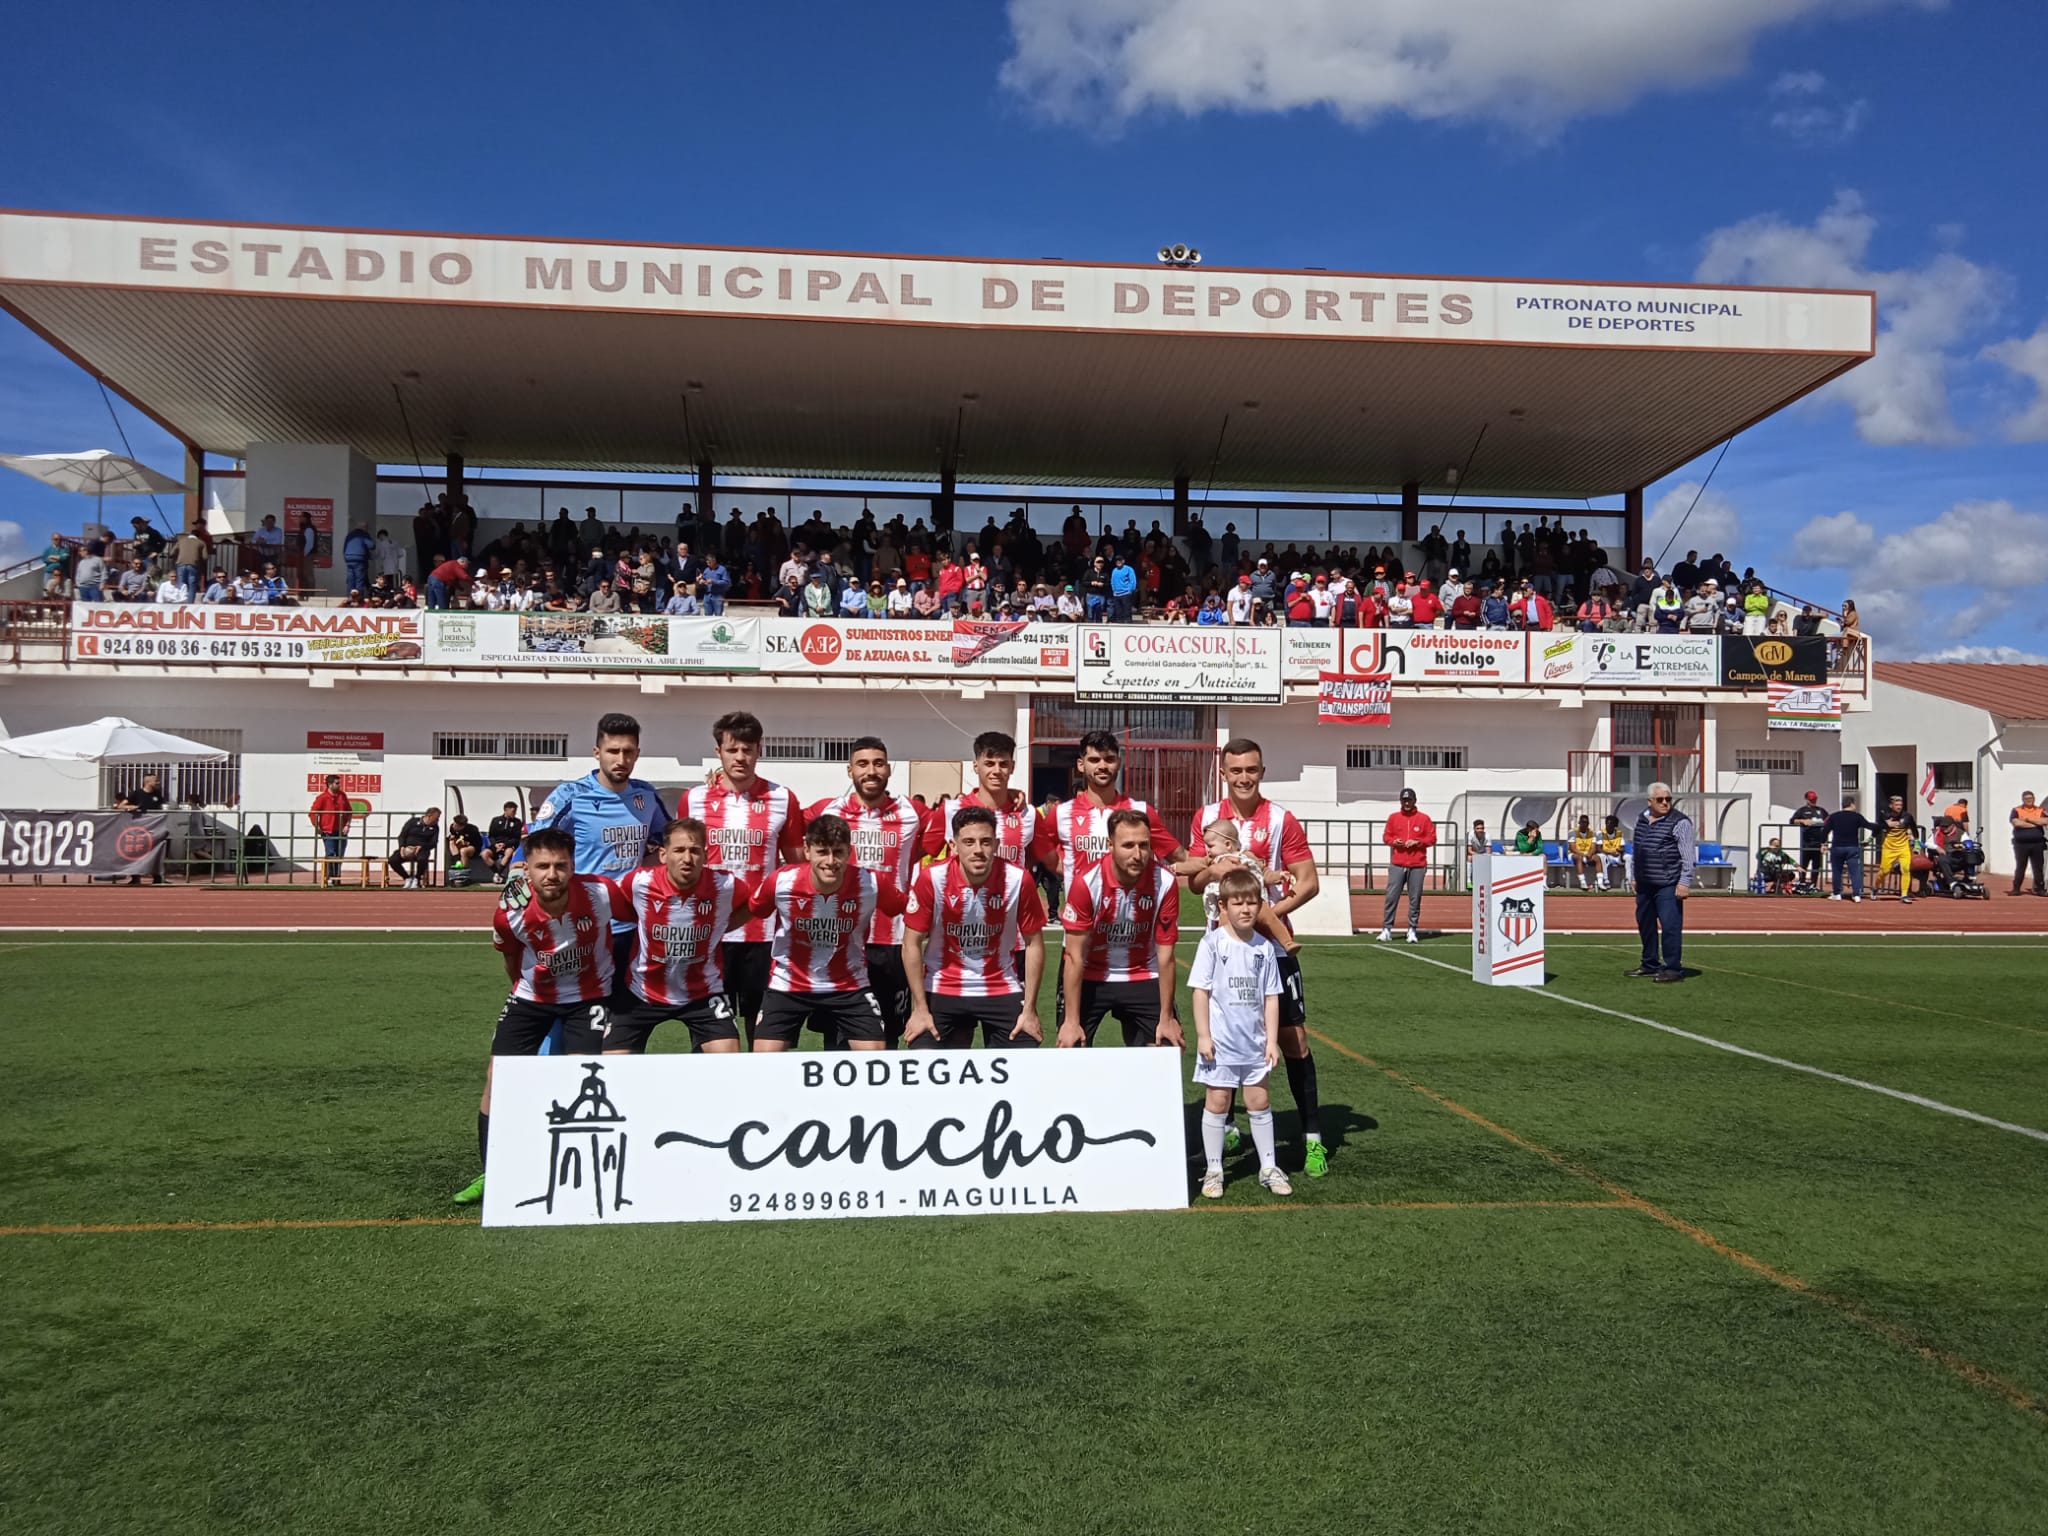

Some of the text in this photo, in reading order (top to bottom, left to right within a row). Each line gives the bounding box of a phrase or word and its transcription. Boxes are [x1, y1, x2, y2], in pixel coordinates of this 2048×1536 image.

[140, 237, 1473, 325] ESTADIO MUNICIPAL DE DEPORTES
[1516, 297, 1743, 317] PATRONATO MUNICIPAL
[1568, 316, 1696, 333] DE DEPORTES
[81, 606, 418, 634] JOAQUÍN BUSTAMANTE
[846, 628, 923, 641] SUMINISTROS
[1024, 634, 1038, 643] 924
[1040, 634, 1055, 644] 137
[1056, 635, 1069, 644] 781
[1410, 634, 1520, 650] distribuciones
[103, 638, 131, 654] 924
[135, 639, 154, 655] 89
[158, 640, 177, 656] 08
[181, 640, 200, 656] 36
[210, 641, 237, 657] 647
[241, 641, 259, 657] 95
[264, 642, 282, 658] 32
[288, 643, 304, 658] 19
[765, 635, 801, 653] SEA
[1124, 635, 1267, 657] COGACSUR, S.L.
[322, 651, 329, 661] Y
[481, 654, 547, 663] ESPECIALISTAS
[549, 655, 561, 663] EN
[563, 655, 592, 664] BODAS
[602, 656, 642, 665] EVENTOS
[645, 657, 654, 665] AL
[680, 658, 705, 666] LIBRE
[846, 649, 932, 662] DE AZUAGA S.L.
[938, 655, 950, 663] Con
[1011, 656, 1037, 665] localidad
[1288, 656, 1331, 666] Cruzcampo
[1350, 632, 1406, 675] dh
[1435, 651, 1496, 669] hidalgo
[1620, 652, 1633, 660] LA
[1124, 660, 1161, 668] Comercial
[1163, 660, 1197, 668] Ganadera
[1102, 669, 1256, 690] Expertos en Nutrición
[1770, 670, 1782, 681] de
[1785, 670, 1816, 681] Maren
[1322, 679, 1366, 700] PEÑA
[602, 824, 648, 844] CORVILLO
[709, 828, 763, 846] CORVILLO
[849, 830, 897, 846] ORVILLO
[613, 841, 639, 858] VERA
[720, 844, 749, 861] VERA
[856, 847, 884, 862] VERA
[796, 917, 853, 932] CORVILLO
[946, 922, 1001, 937] CORVILLO
[651, 924, 712, 942] CORVILLO
[808, 930, 839, 944] VERA
[1106, 931, 1136, 943] VERA
[665, 942, 696, 957] VERA
[958, 935, 989, 948] VERA
[550, 957, 581, 976] VERA
[802, 1057, 1010, 1087] BODEGAS
[654, 1100, 1156, 1179] cancho
[729, 1190, 886, 1212] 924899681
[919, 1185, 1079, 1208] MAGUILLA
